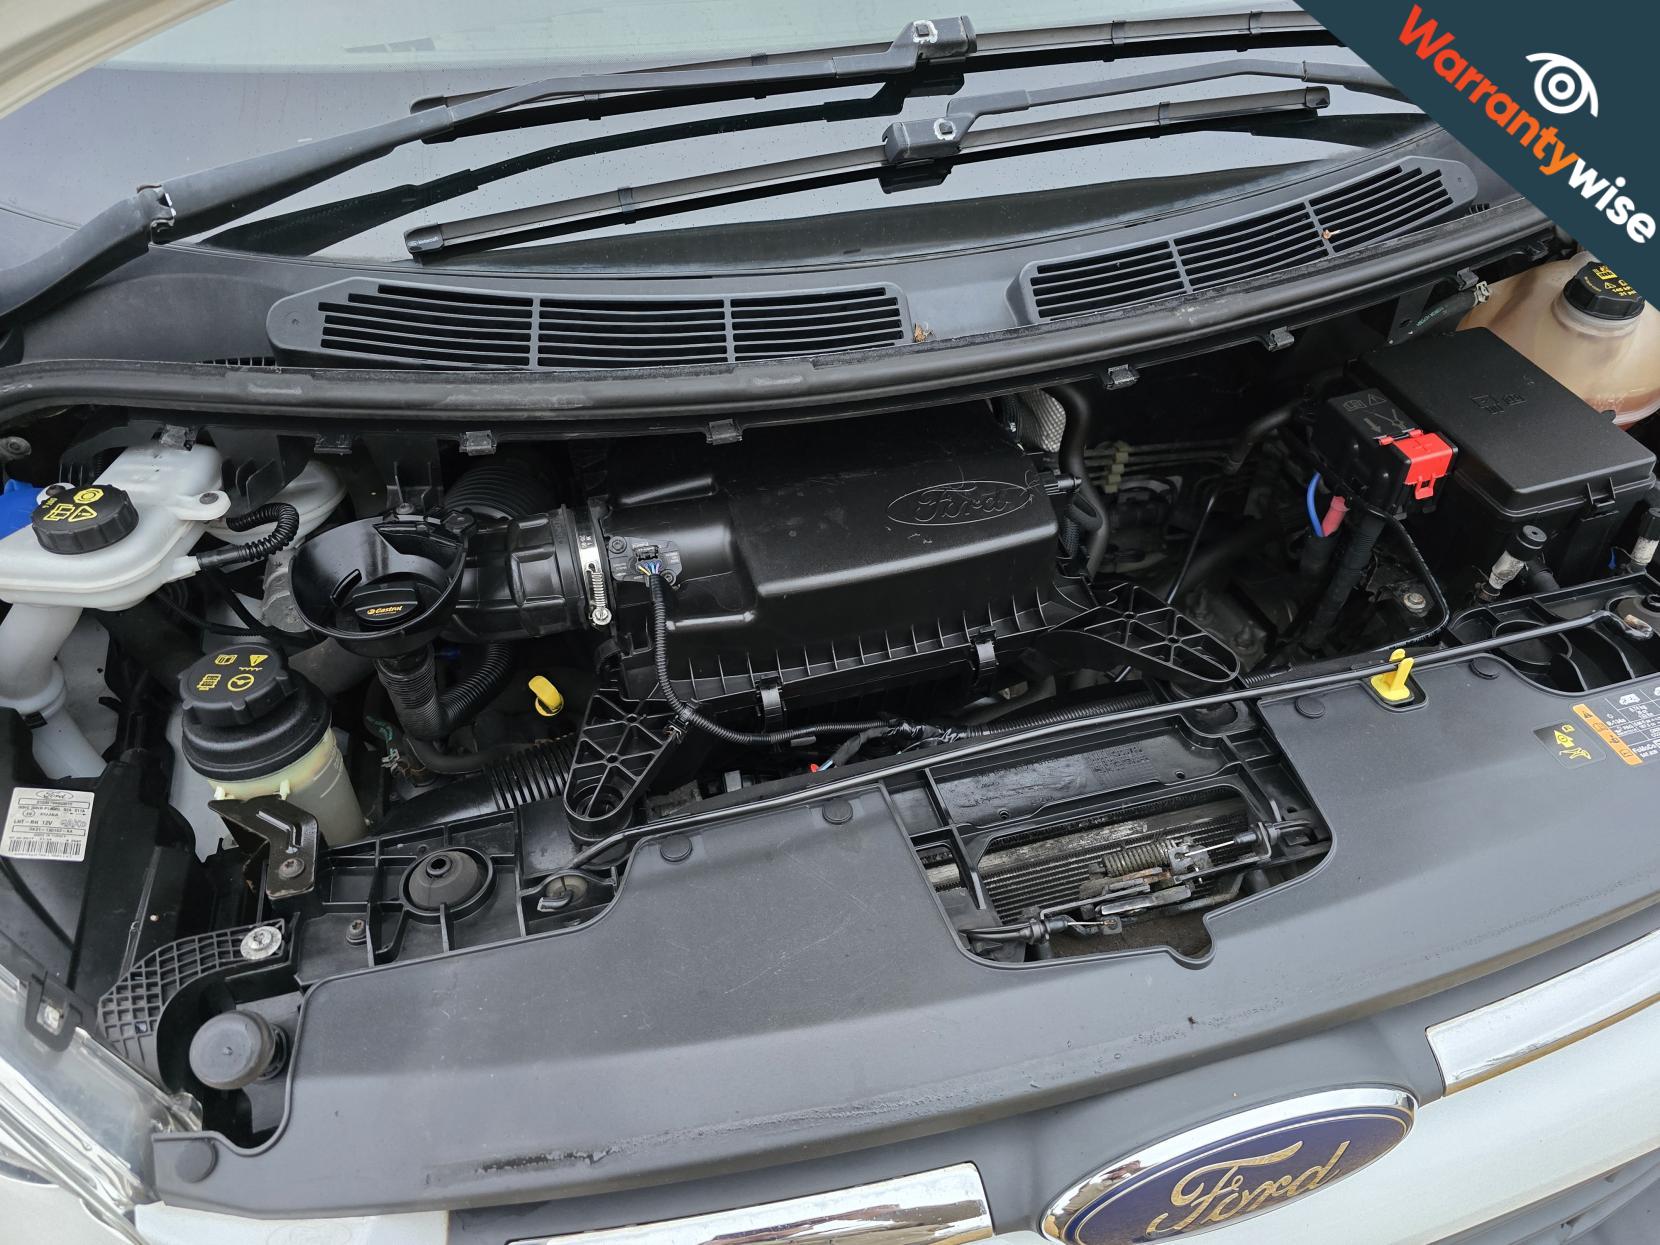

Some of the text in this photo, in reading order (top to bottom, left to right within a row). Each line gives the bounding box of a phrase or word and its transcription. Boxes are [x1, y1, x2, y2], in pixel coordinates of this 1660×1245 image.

[914, 485, 1018, 522] Ford
[375, 606, 403, 614] Castrol
[1145, 1140, 1351, 1236] Ford
